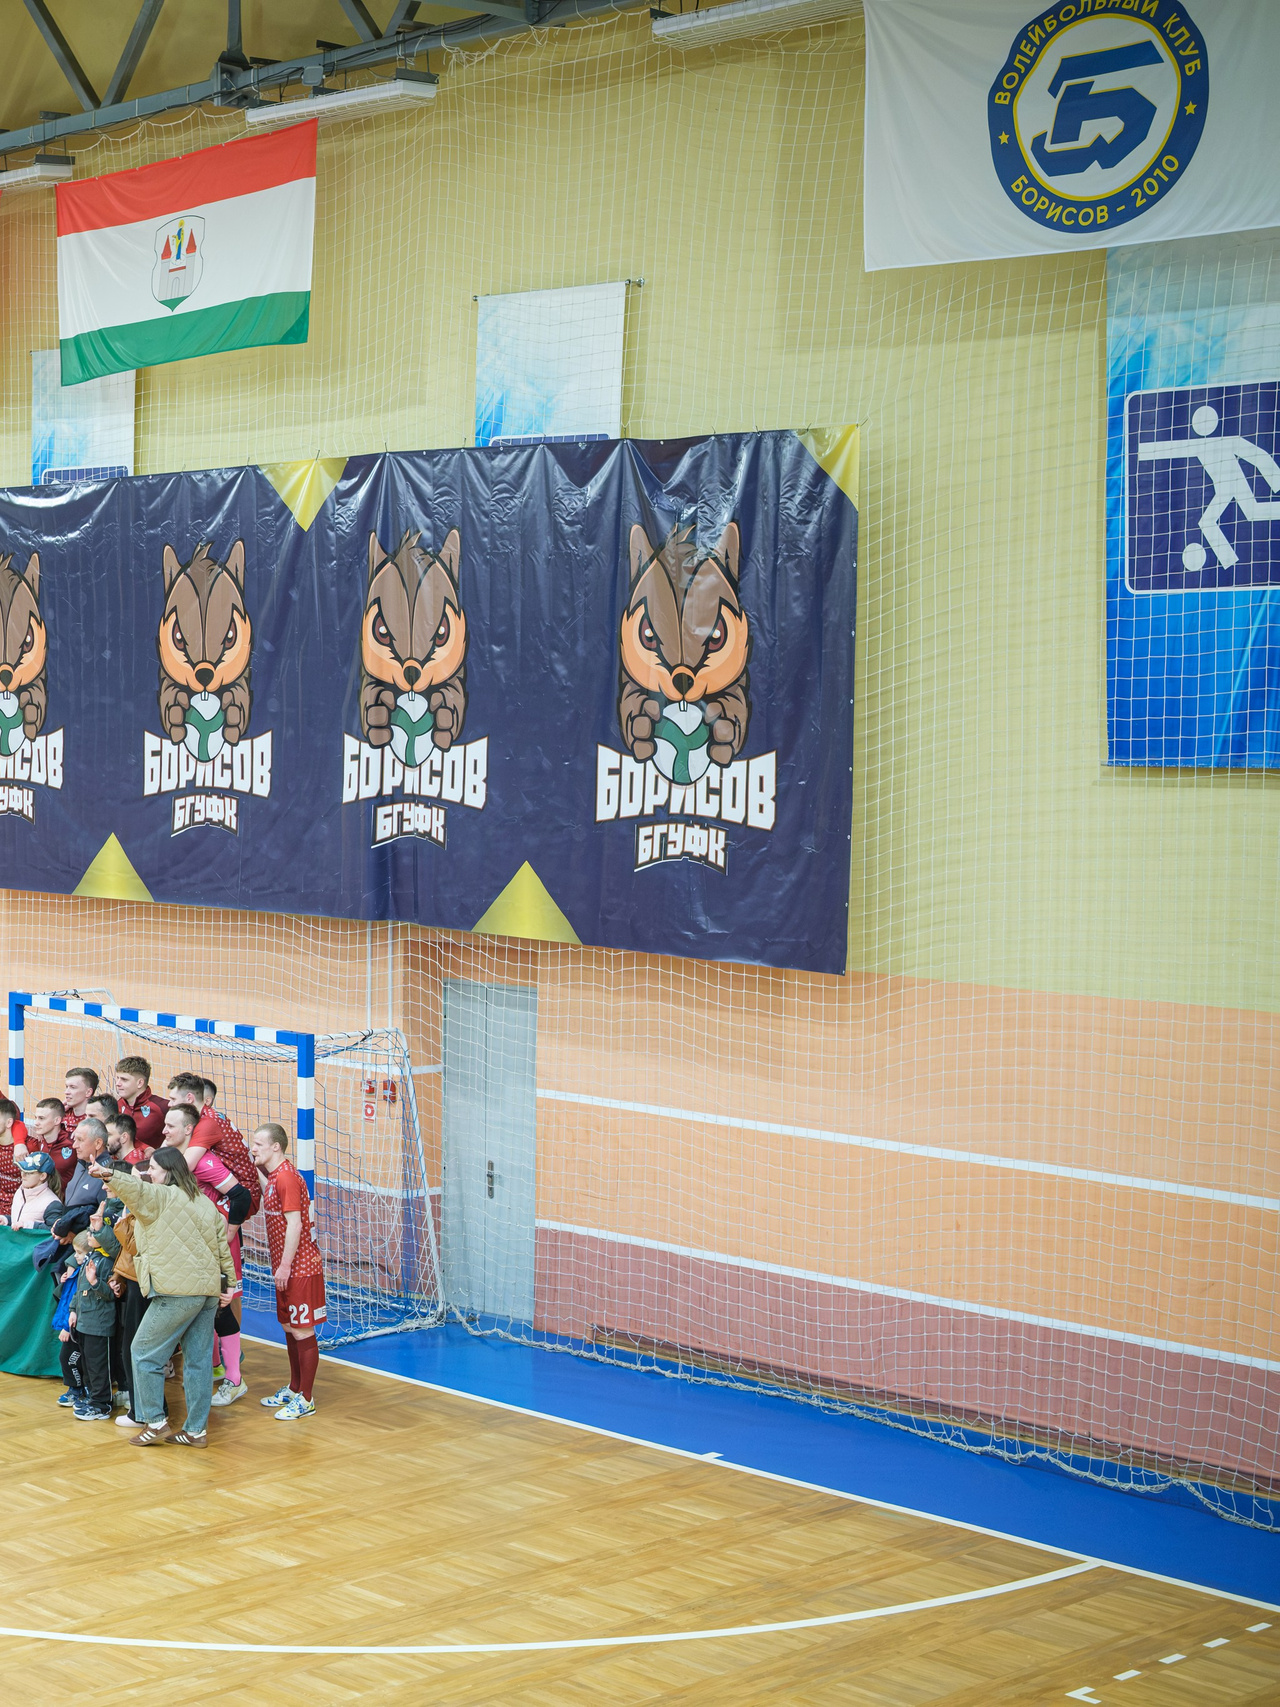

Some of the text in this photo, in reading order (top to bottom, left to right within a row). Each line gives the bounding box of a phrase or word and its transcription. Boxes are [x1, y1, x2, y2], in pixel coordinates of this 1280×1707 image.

[1163, 13, 1202, 77] КЛУБ
[1010, 174, 1109, 227] БОРИСОВ
[1130, 154, 1179, 209] 2010
[173, 795, 238, 832] БГУФК
[375, 802, 445, 844] БГУФК
[637, 823, 726, 869] БГУФК
[289, 1303, 310, 1324] 22
